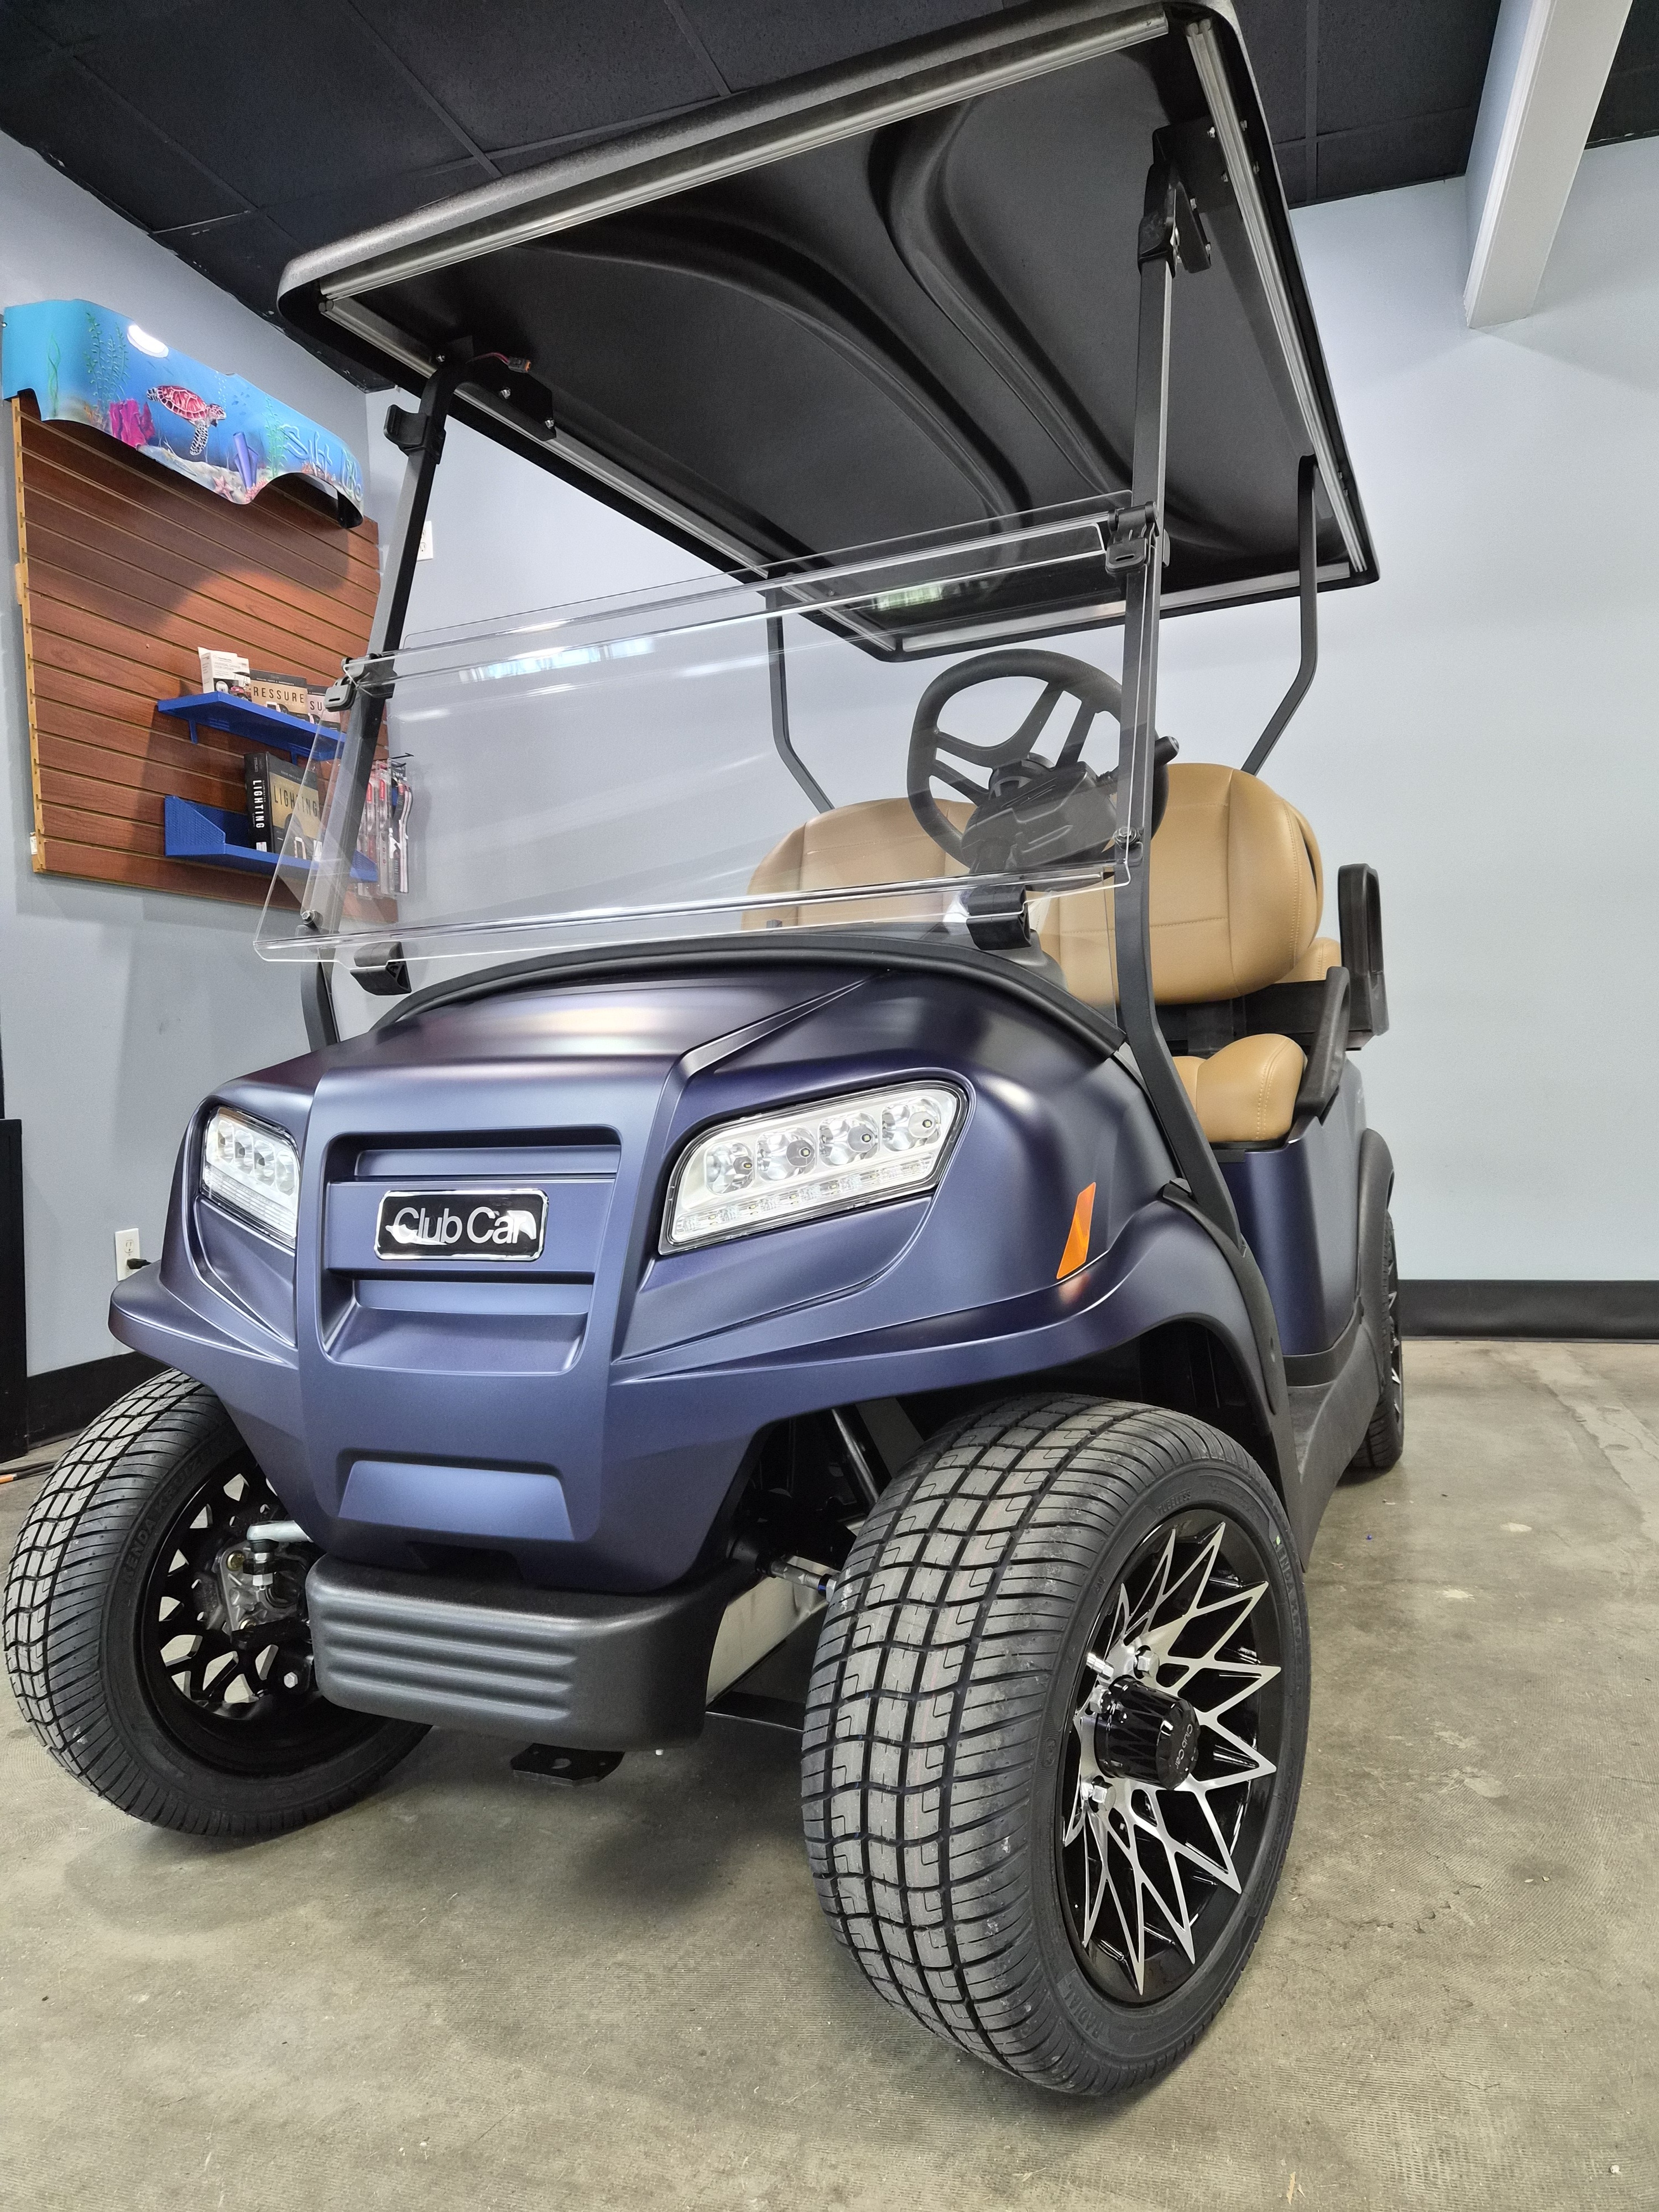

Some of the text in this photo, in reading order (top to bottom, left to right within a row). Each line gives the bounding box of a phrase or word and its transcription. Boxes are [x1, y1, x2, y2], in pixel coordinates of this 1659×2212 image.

[253, 686, 305, 704] RESSURE
[253, 780, 265, 828] LIGHTING
[393, 1206, 525, 1244] Club Car
[122, 1518, 156, 1580] KENDA
[1175, 1724, 1193, 1769] Club Car
